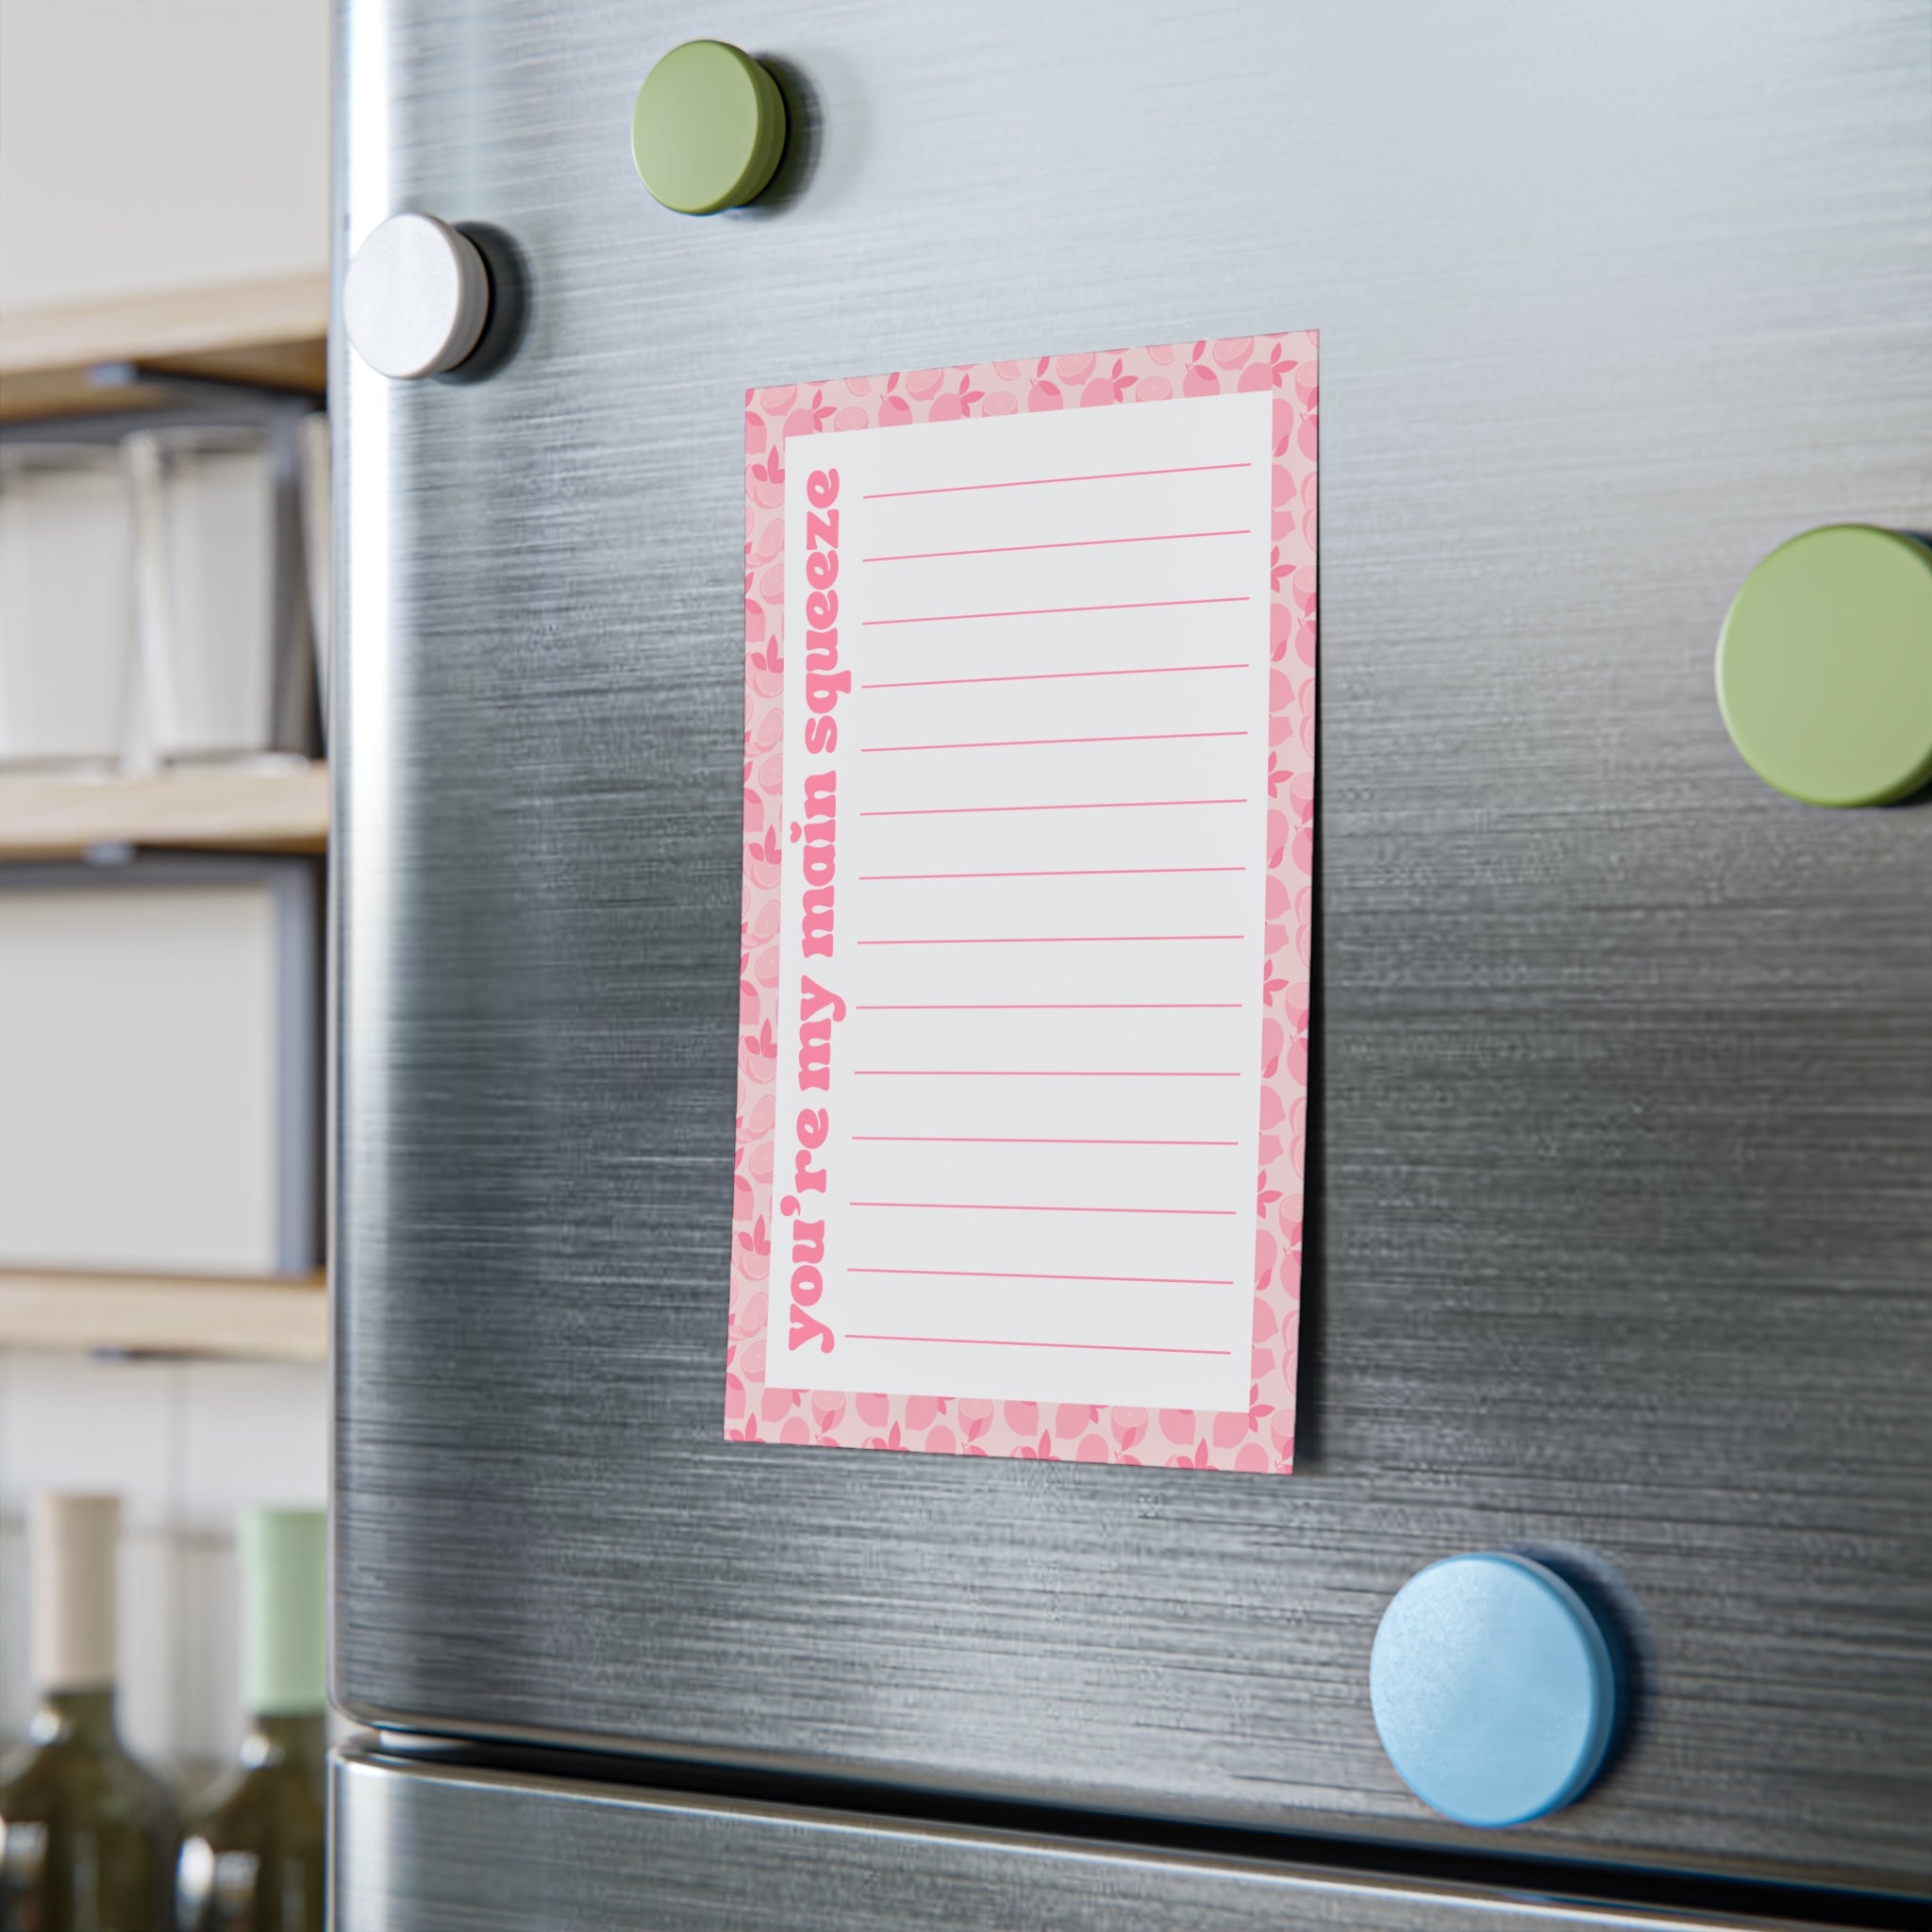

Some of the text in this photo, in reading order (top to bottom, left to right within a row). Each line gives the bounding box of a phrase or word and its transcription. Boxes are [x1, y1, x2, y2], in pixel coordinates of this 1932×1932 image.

[779, 468, 851, 1354] you're my main squeeze
